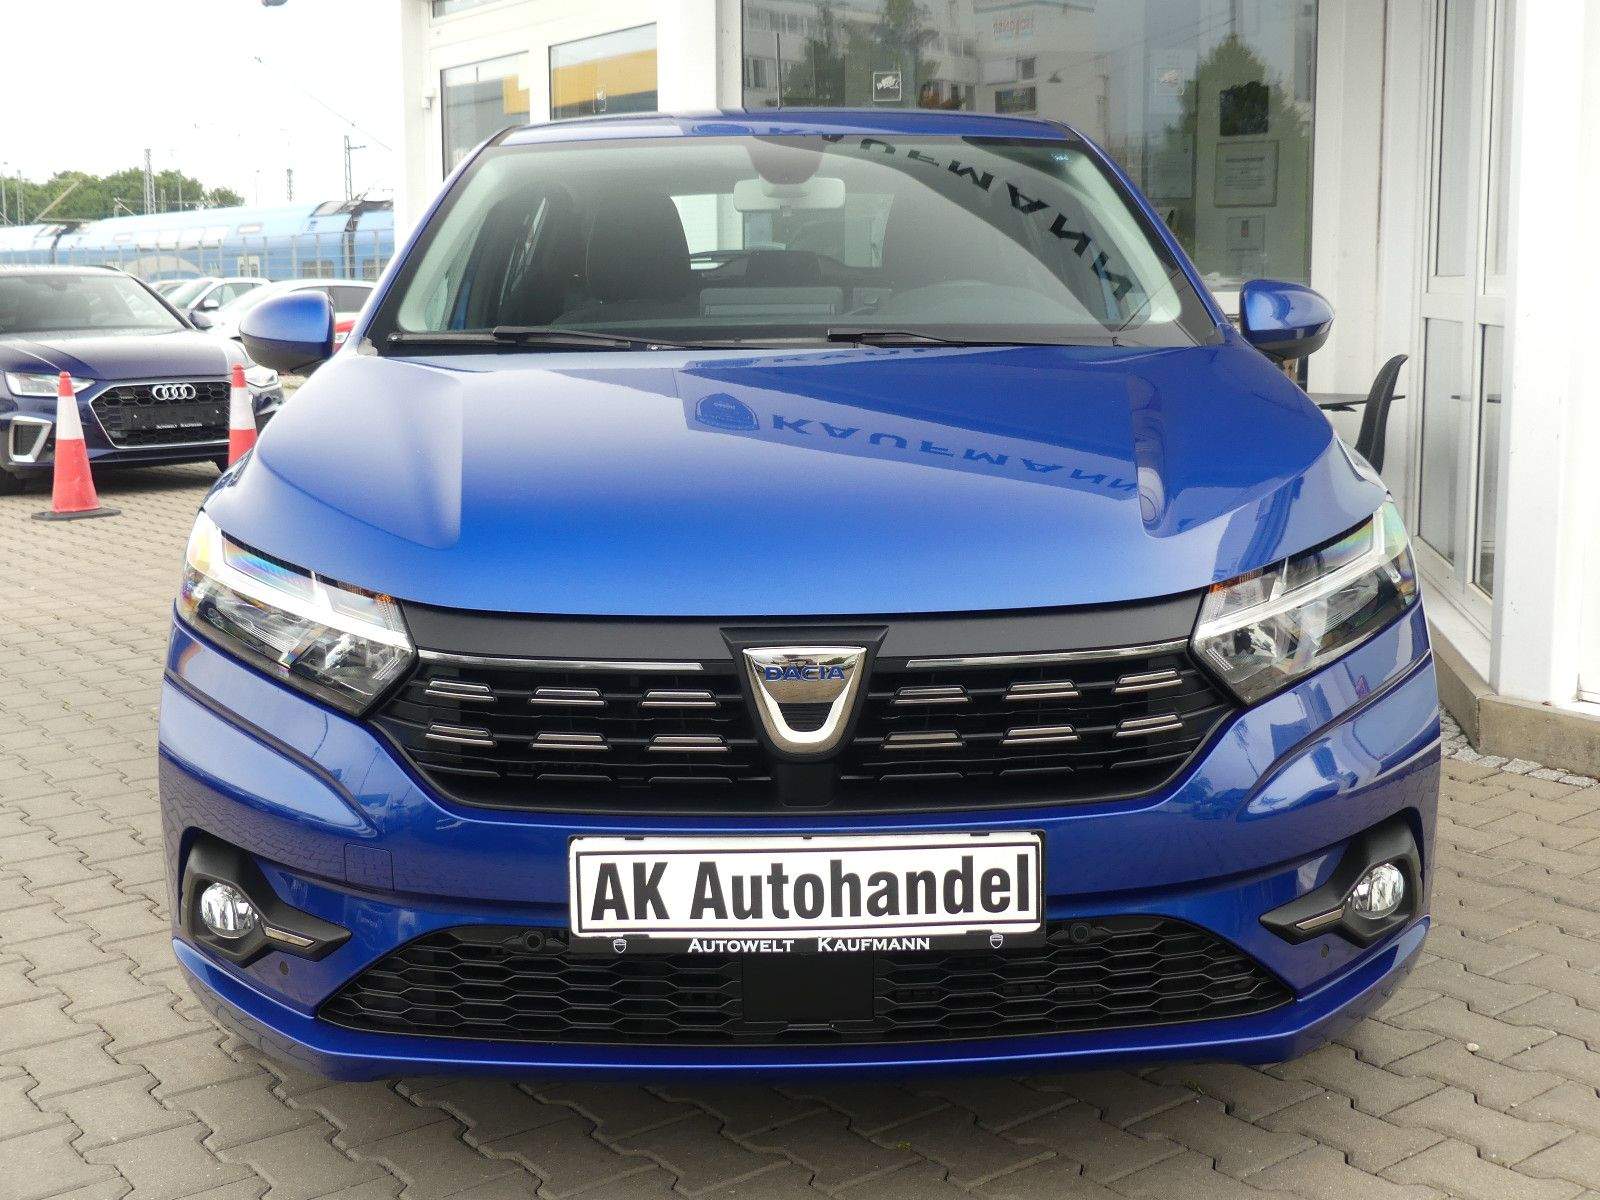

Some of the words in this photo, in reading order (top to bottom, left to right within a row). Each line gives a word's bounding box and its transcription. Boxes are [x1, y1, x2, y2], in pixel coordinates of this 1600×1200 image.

[764, 664, 845, 681] DACIA
[590, 861, 670, 921] AK
[689, 853, 1030, 920] Autohandel
[687, 938, 795, 953] AUTOWELT
[817, 936, 930, 952] KAUFMANN
